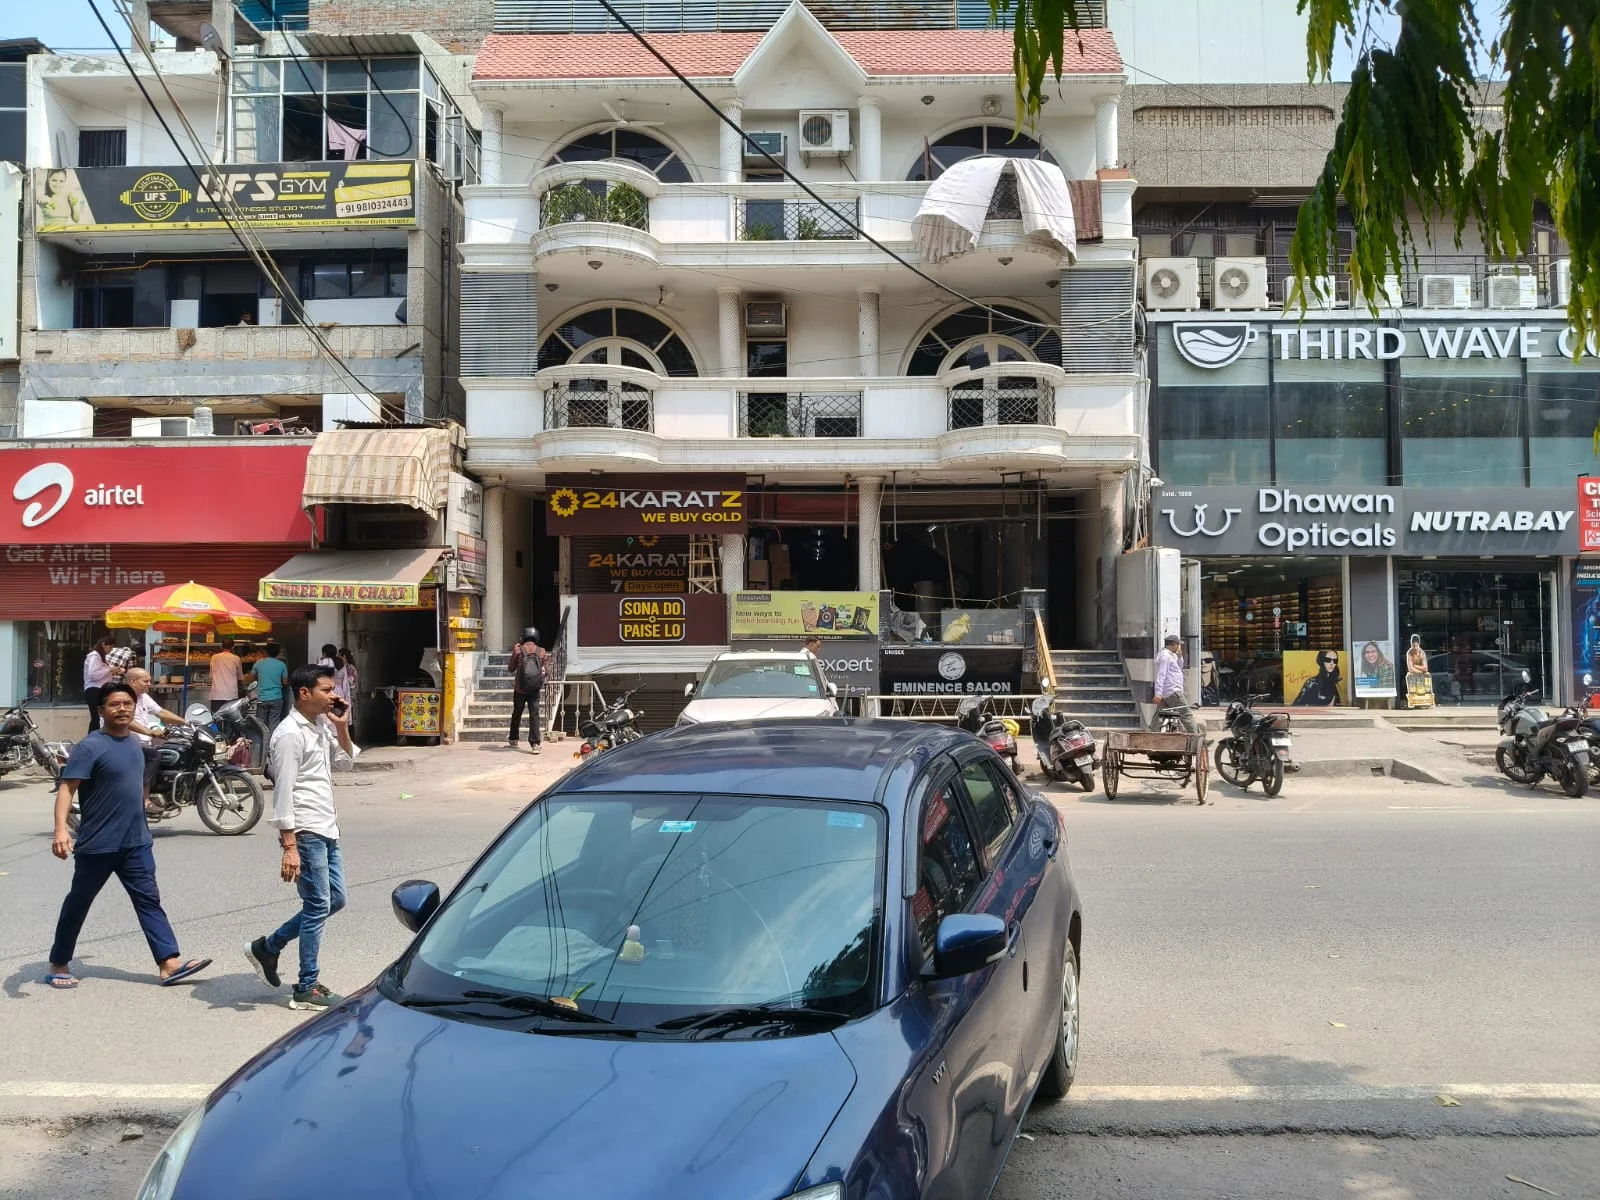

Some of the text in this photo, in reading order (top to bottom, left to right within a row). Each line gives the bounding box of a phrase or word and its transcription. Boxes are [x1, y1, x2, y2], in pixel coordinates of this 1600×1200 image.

[196, 172, 279, 202] UFS
[280, 179, 327, 193] GYM
[144, 192, 167, 202] UFS
[1271, 326, 1406, 360] THIRD
[1418, 325, 1542, 360] WAVE
[84, 483, 144, 506] airtel
[582, 490, 743, 509] 24KARATZ
[1258, 488, 1395, 514] Dhawan
[641, 512, 743, 524] WE BUY GOLD
[1410, 509, 1576, 533] NUTRABAY
[1258, 521, 1396, 552] Opticals
[6, 544, 111, 562] Get Airtel
[48, 566, 166, 585] Wi-Fi here
[609, 568, 685, 577] WE BUY GOLD
[270, 584, 318, 599] SHREE
[321, 585, 355, 600] RAM
[357, 586, 408, 600] CHAAT
[610, 580, 623, 593] 7
[623, 601, 681, 616] SONA DO
[623, 623, 681, 638] PAISE LO
[893, 682, 1011, 693] EMINENCE SALON
